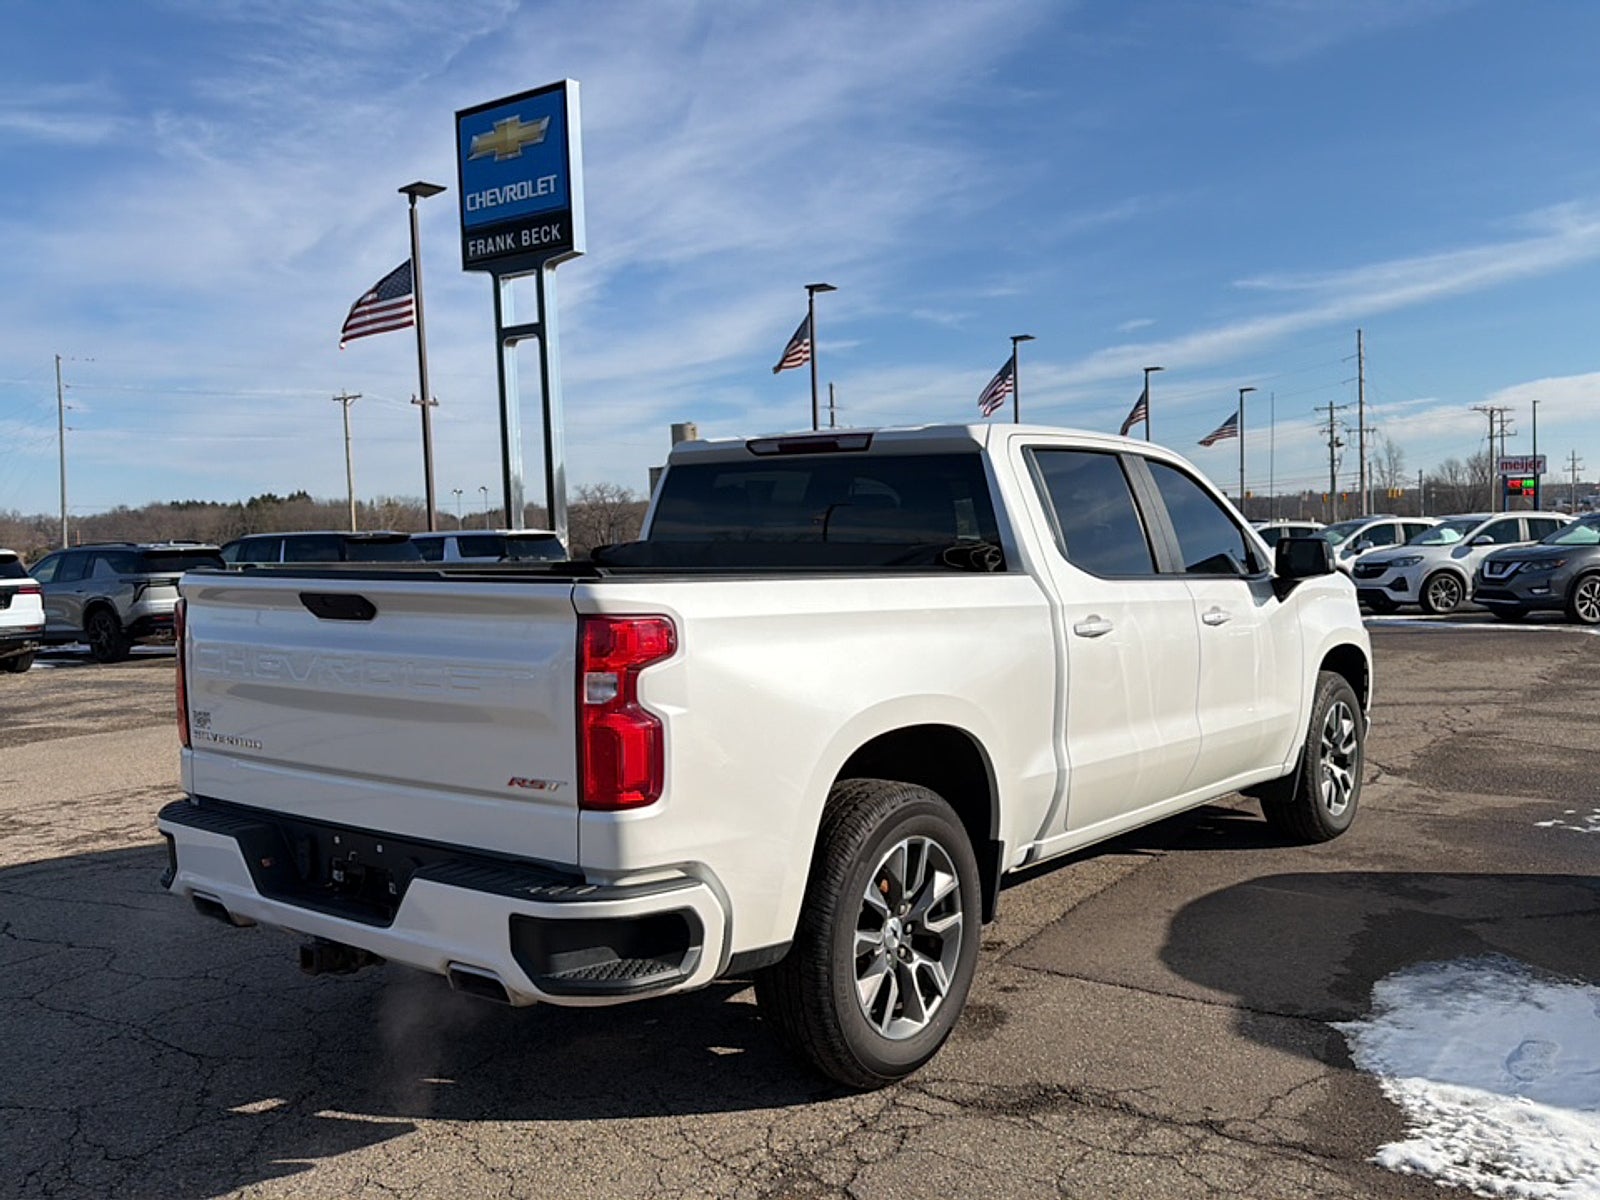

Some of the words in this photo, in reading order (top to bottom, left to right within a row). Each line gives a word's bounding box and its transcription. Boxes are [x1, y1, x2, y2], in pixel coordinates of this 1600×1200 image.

[467, 174, 557, 211] CHEVROLET
[468, 234, 516, 257] FRANK
[521, 223, 561, 247] BECK
[1501, 458, 1542, 473] meijer
[194, 645, 537, 693] CHEVROLET
[506, 776, 568, 792] RST
